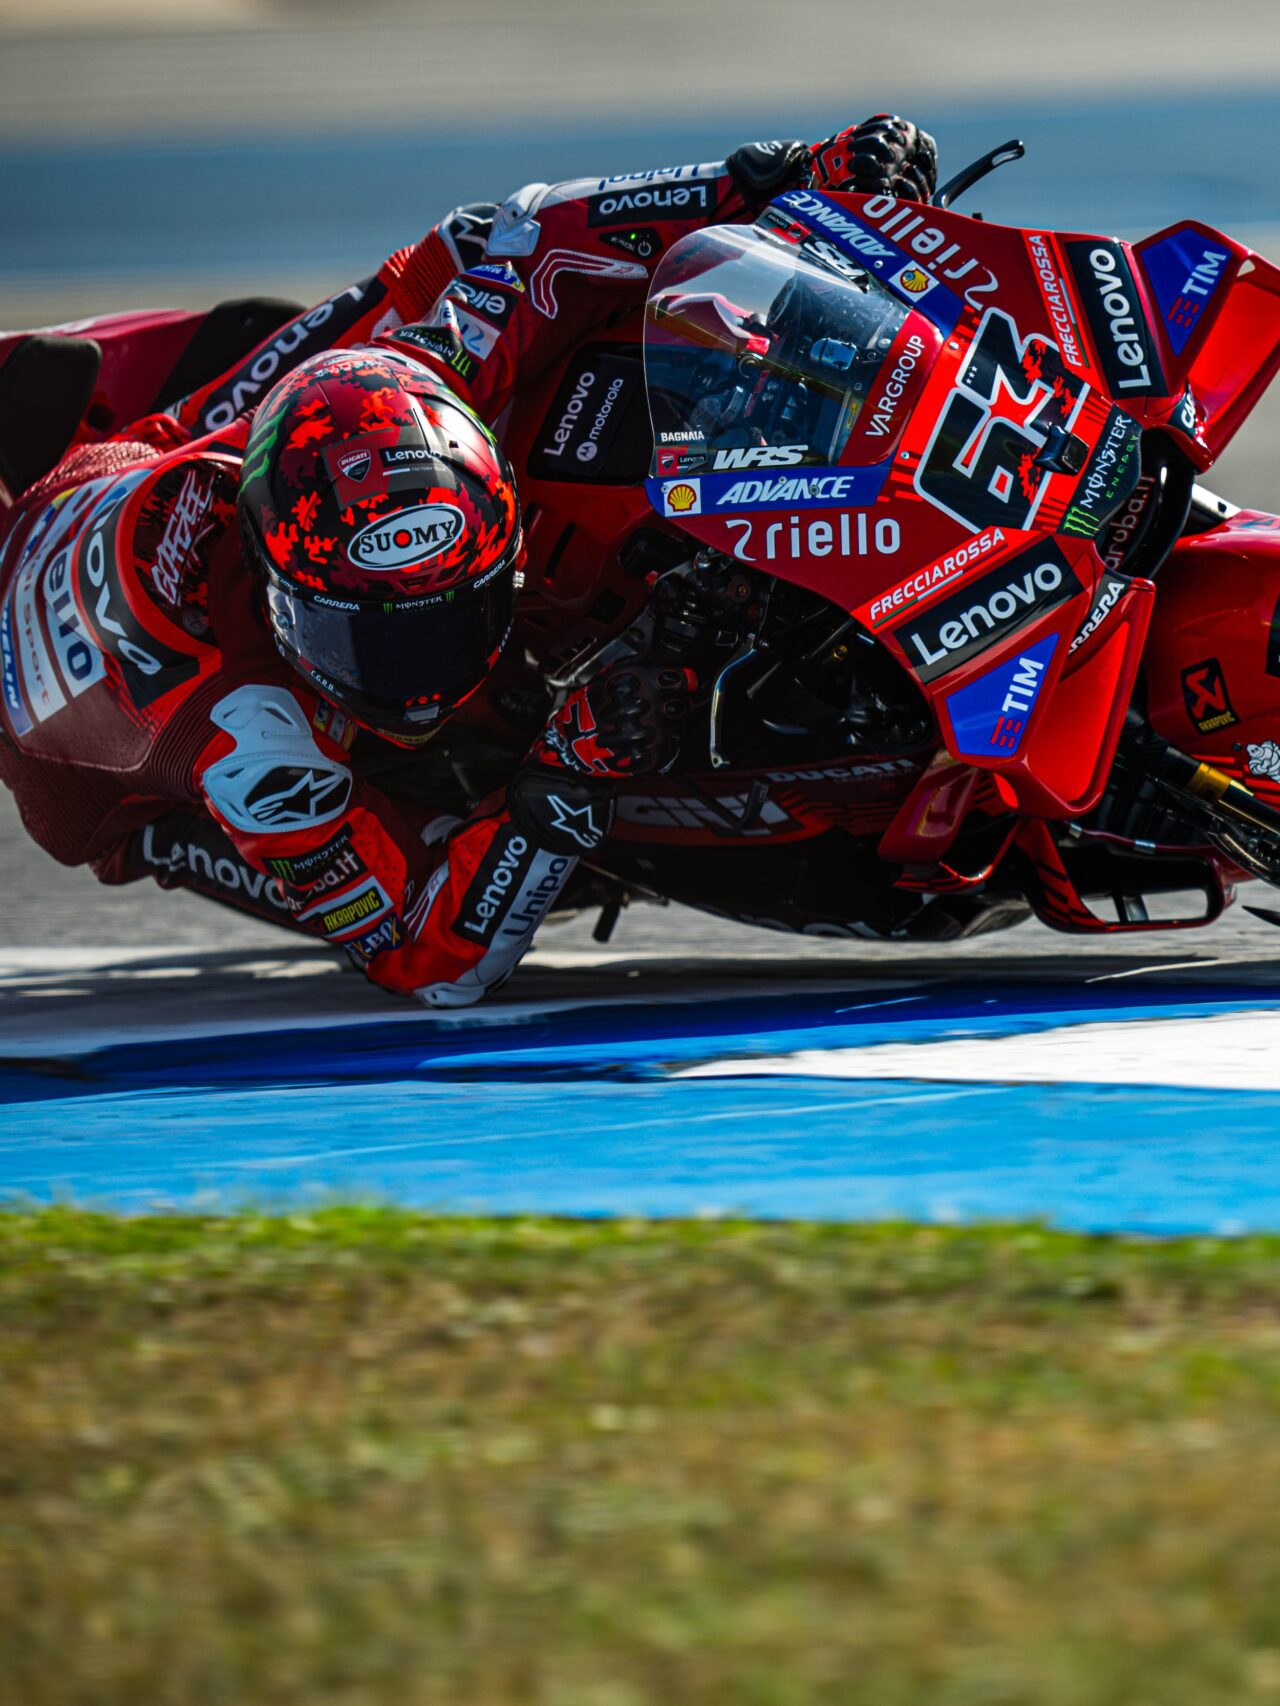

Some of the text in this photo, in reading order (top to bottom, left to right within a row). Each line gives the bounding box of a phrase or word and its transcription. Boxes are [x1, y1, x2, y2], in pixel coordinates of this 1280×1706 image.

[599, 186, 707, 214] Lenovo
[782, 191, 899, 257] ADVANCE
[862, 194, 979, 280] riello
[1028, 235, 1082, 366] FRECCIAROSSA
[1182, 251, 1227, 296] TIM
[1090, 248, 1151, 388] Lenovo
[205, 286, 364, 431] Lenovo
[865, 335, 925, 436] VARGROUP
[544, 372, 595, 456] Lenovo
[589, 378, 624, 440] motorola
[661, 431, 705, 442] BAGNAIA
[341, 452, 368, 466] DUCATI
[385, 450, 443, 462] Lenovo
[713, 444, 808, 470] WRS
[1080, 414, 1132, 508] MONSTER
[1106, 434, 1138, 499] ENERGY
[716, 476, 854, 505] ADVANCE
[360, 520, 455, 554] SUOMY
[766, 513, 900, 559] riello
[313, 595, 360, 611] CARRERA
[473, 559, 506, 589] CARRERA
[870, 528, 1005, 620] FRECCIAROSSA
[911, 563, 1062, 665] Lenovo
[1068, 581, 1125, 654] ARRERA
[1002, 658, 1044, 712] TIM
[767, 759, 915, 783] DUCATI
[143, 825, 290, 911] Lenovo
[464, 836, 528, 935] Lenovo
[502, 858, 568, 937] Unipo
